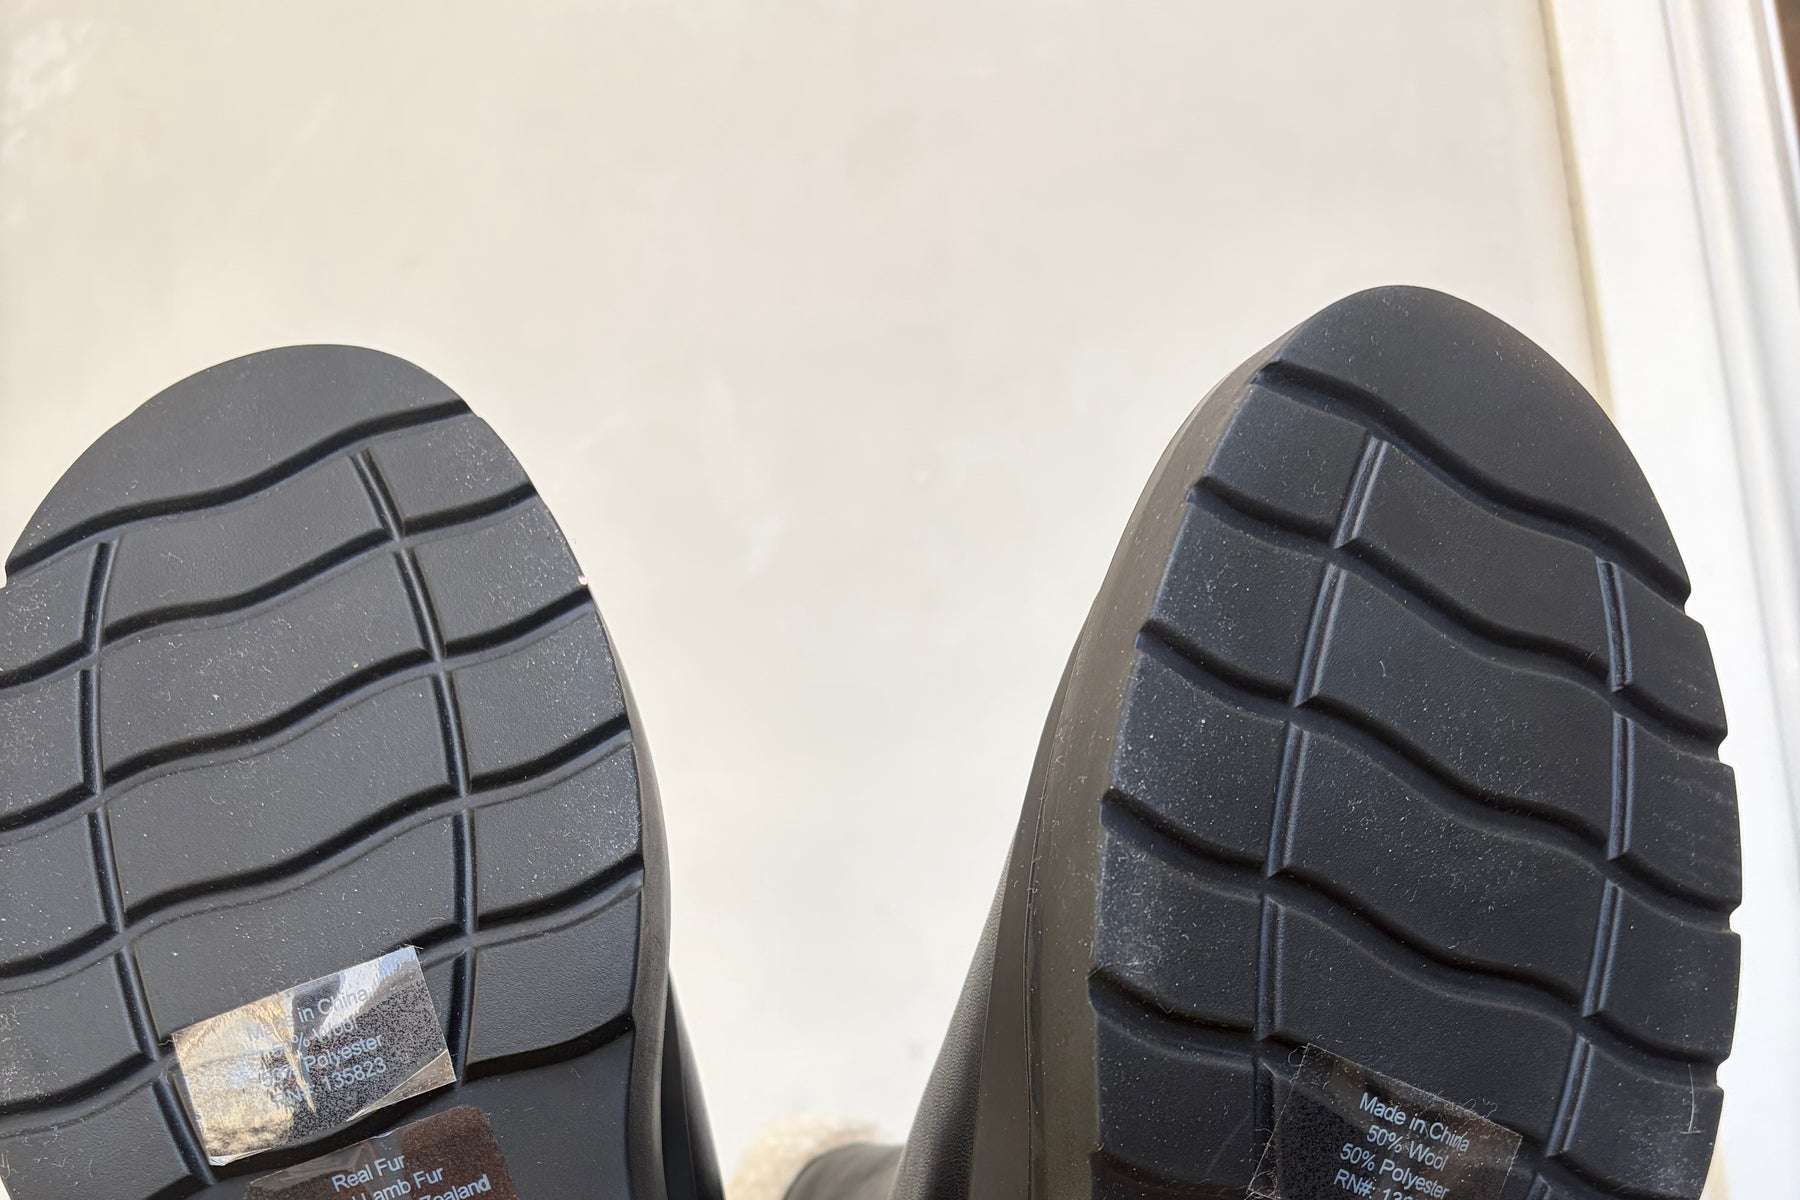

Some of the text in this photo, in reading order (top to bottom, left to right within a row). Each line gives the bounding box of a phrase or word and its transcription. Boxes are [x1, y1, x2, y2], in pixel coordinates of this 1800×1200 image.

[298, 1006, 315, 1023] in
[318, 988, 368, 1016] China
[313, 1017, 360, 1044] Wool
[303, 1034, 383, 1074] Polyester
[321, 1057, 387, 1092] 135823
[1359, 1092, 1470, 1153] Made in China
[1366, 1125, 1449, 1172] 50% Wool
[332, 1154, 405, 1192] Real Fur
[413, 1167, 444, 1189] Fur
[1340, 1143, 1450, 1200] 50% Polyester
